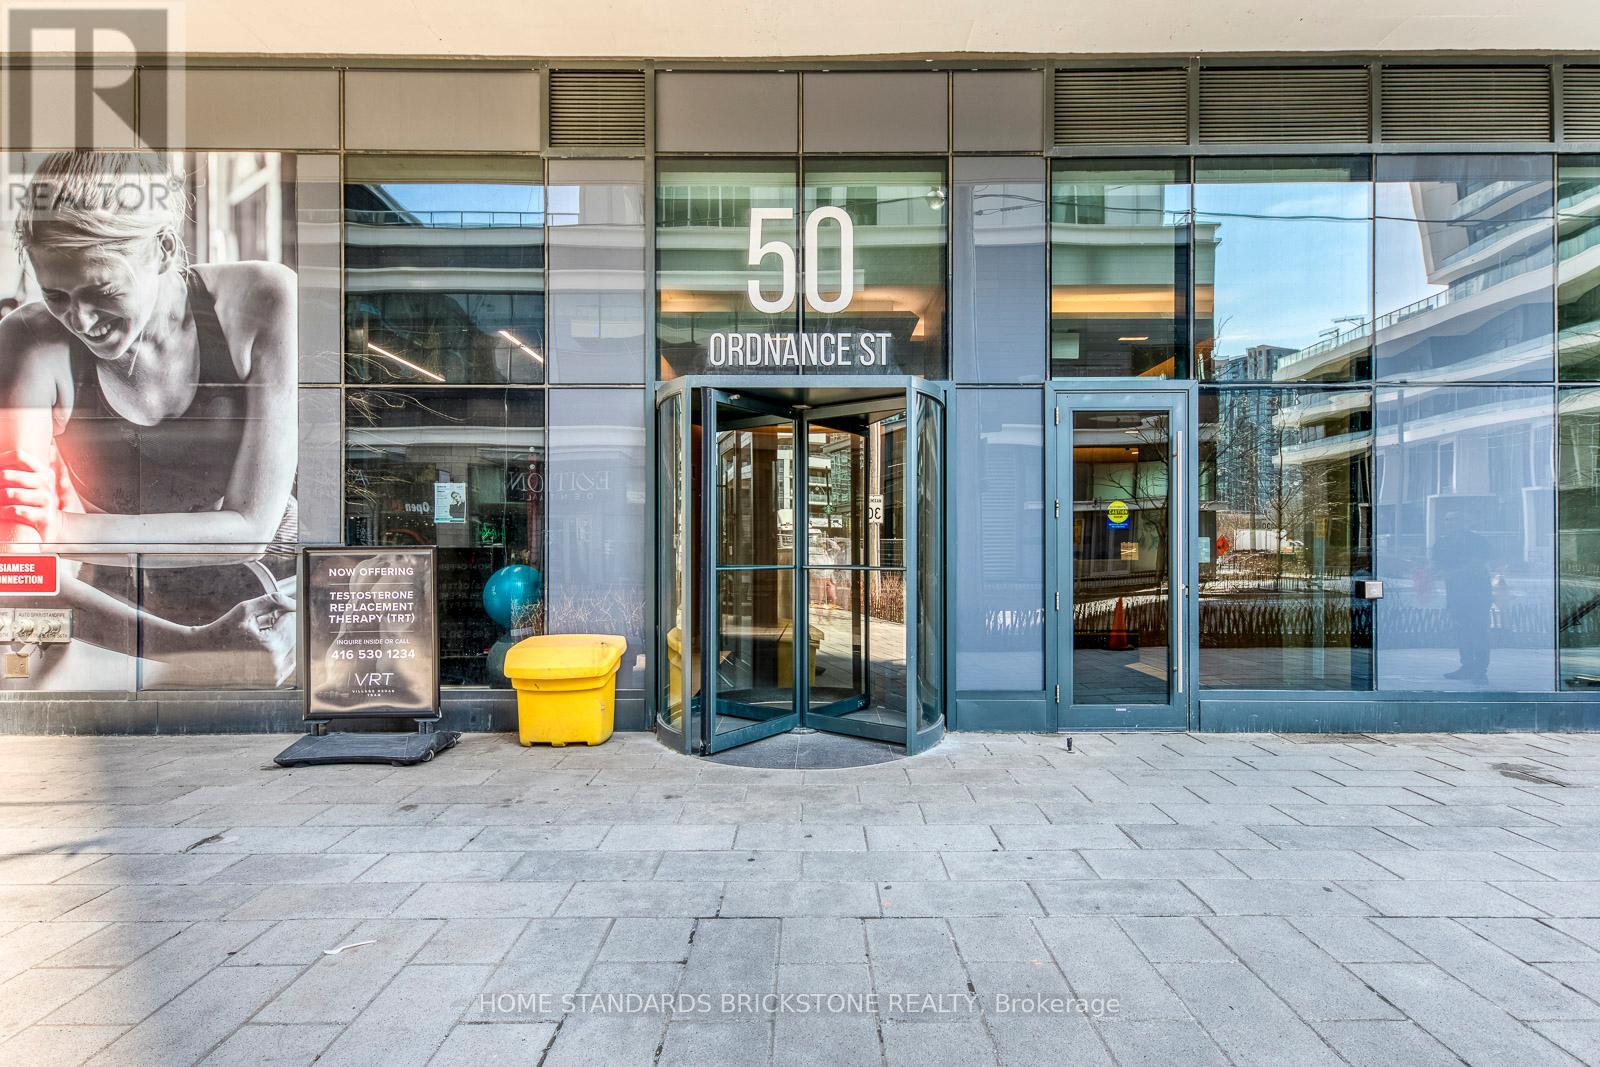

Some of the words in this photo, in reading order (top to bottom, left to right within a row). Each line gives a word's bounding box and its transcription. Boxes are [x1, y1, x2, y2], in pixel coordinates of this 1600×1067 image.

[747, 206, 854, 314] 50
[709, 332, 852, 367] ORDNANCE
[859, 332, 892, 367] ST
[0, 563, 36, 573] SIAMESE
[328, 567, 355, 577] NOW
[359, 567, 414, 577] OFFERING
[0, 575, 44, 585] NNECTION
[329, 591, 414, 600] TESTOSTERONE
[330, 602, 414, 612] REPLACEMENT
[328, 614, 383, 624] THERAPY
[386, 613, 415, 624] (TRT)
[330, 650, 354, 660] 416
[358, 649, 383, 659] 530
[386, 649, 416, 659] 1234
[354, 672, 394, 686] VRT
